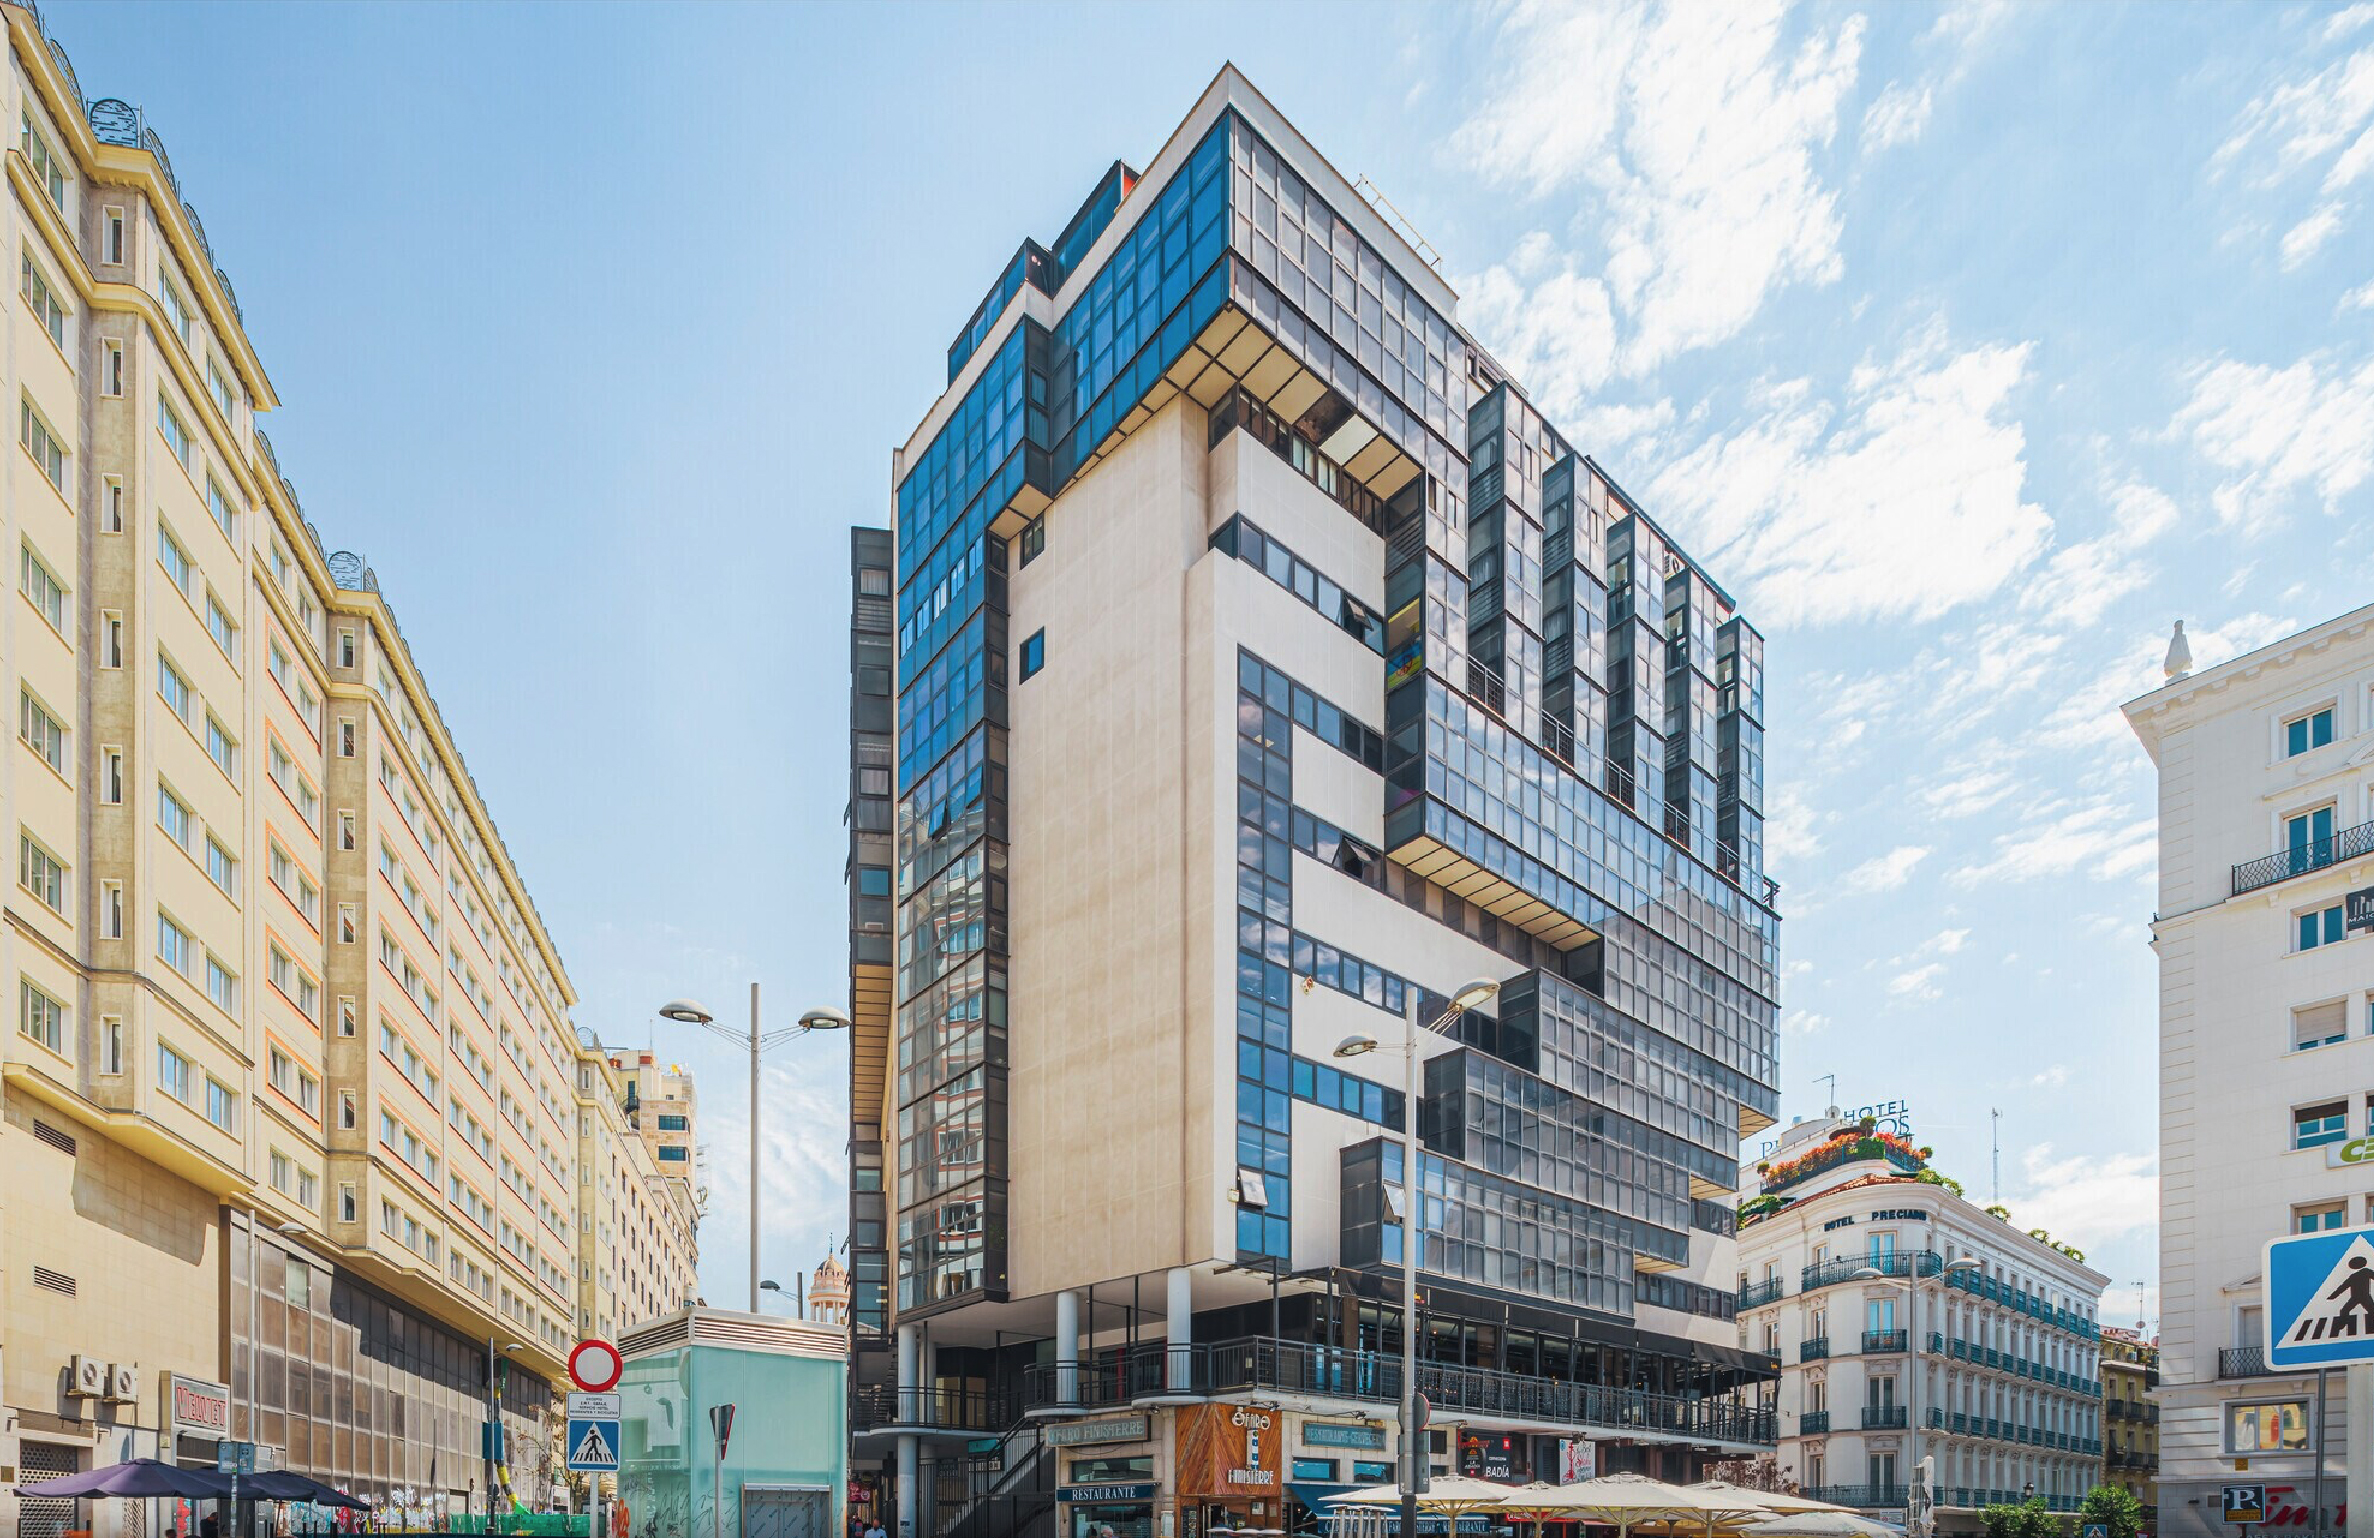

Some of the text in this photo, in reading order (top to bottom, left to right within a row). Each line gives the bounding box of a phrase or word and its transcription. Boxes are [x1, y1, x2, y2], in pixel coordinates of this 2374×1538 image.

[1843, 1099, 1909, 1123] HOTEL
[1823, 1215, 1855, 1232] HOTEL
[176, 1386, 226, 1427] VELVET
[1084, 1421, 1144, 1438] FINISTERRE
[1227, 1469, 1275, 1485] FINISTERRE
[1072, 1486, 1137, 1501] RESTAURANTE
[2229, 1488, 2256, 1510] P
